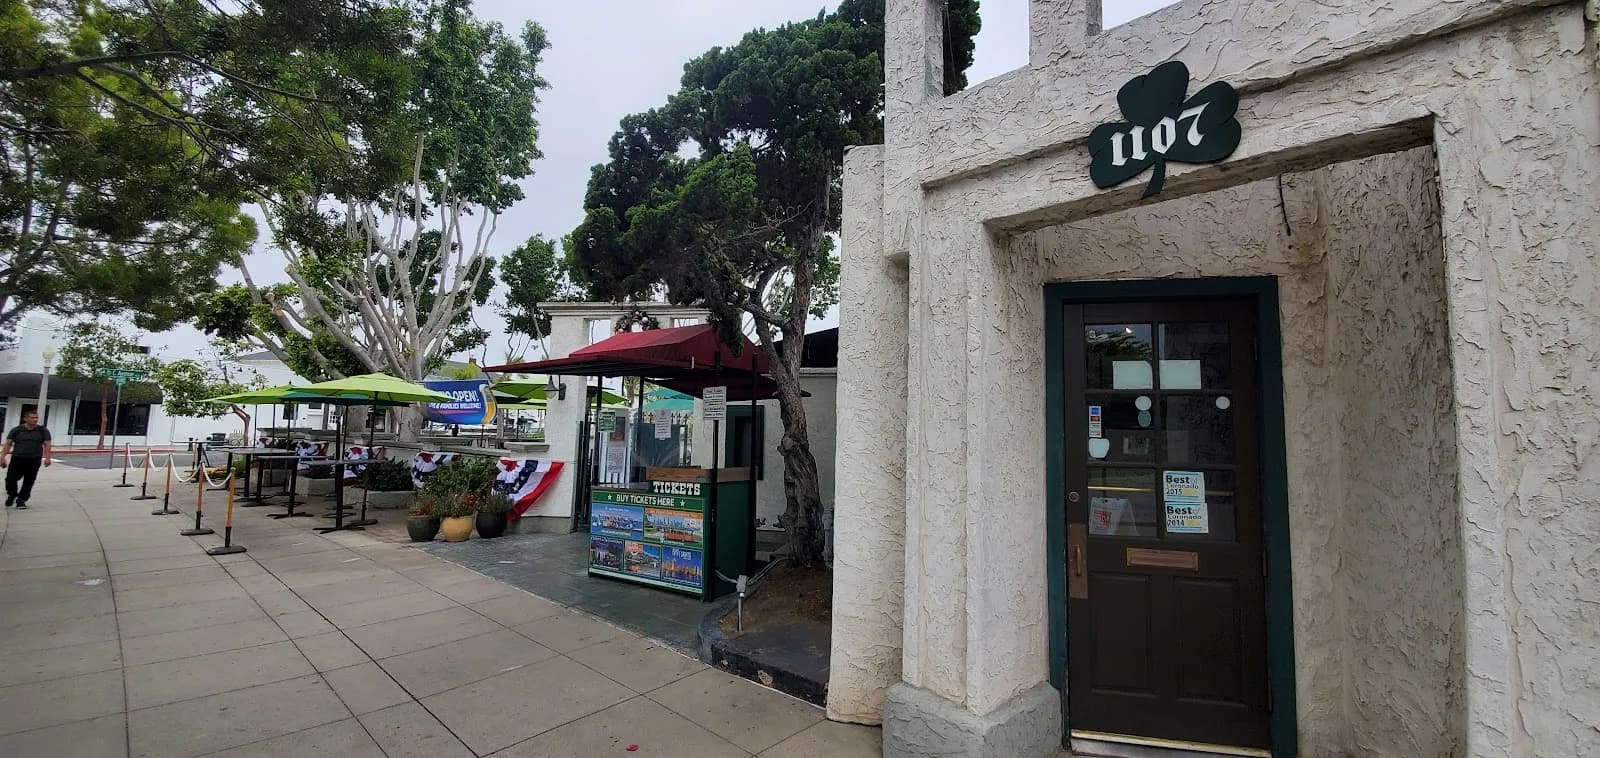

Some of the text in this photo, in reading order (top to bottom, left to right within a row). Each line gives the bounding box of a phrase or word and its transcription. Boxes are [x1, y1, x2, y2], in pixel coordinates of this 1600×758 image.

[1110, 102, 1210, 166] 1107
[452, 390, 480, 402] OPEN!
[1166, 475, 1190, 484] Best
[653, 481, 701, 495] TICKETS
[616, 494, 675, 507] BUY TICKETS HERE
[1167, 505, 1192, 515] Best
